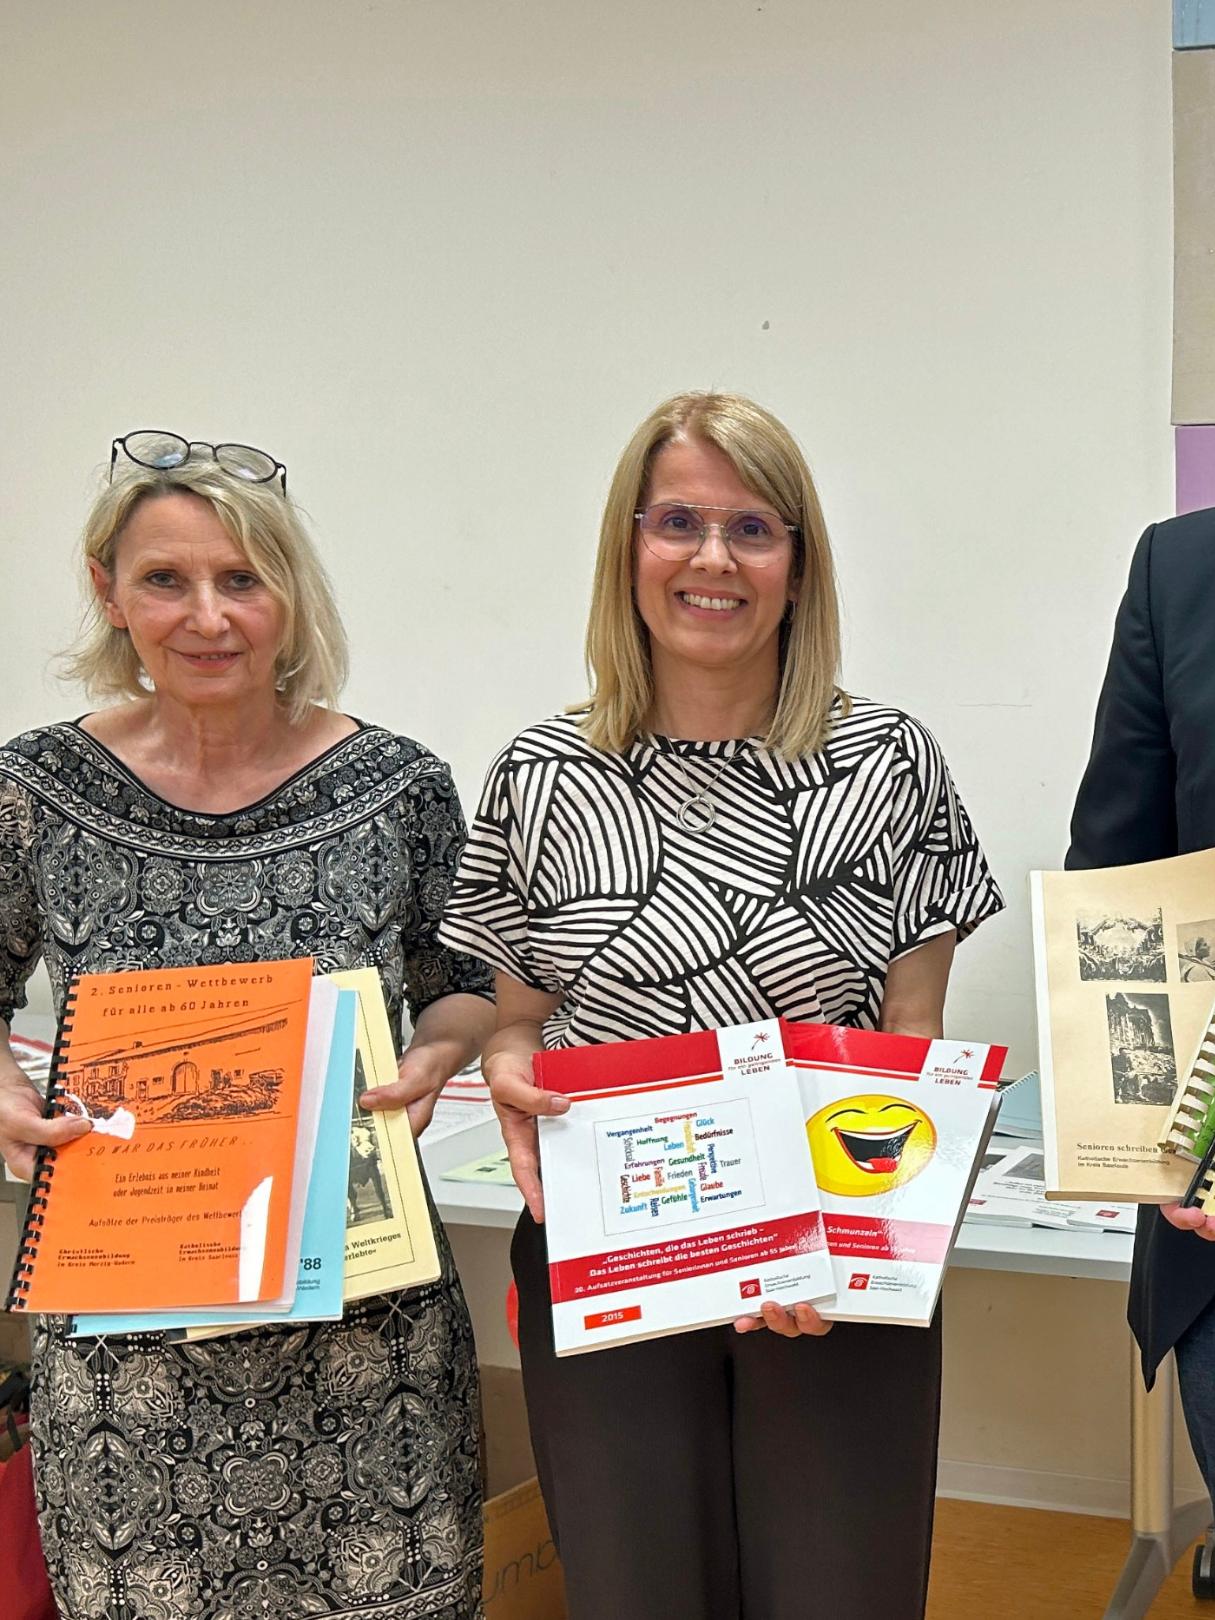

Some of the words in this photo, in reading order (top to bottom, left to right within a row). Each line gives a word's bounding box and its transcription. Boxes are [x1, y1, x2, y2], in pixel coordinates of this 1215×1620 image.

[90, 987, 103, 997] 2.
[109, 982, 172, 996] Senioren
[187, 974, 273, 988] Wettbewerb
[102, 1007, 123, 1017] für
[129, 1005, 155, 1015] alle
[161, 1003, 176, 1013] ab
[180, 1001, 195, 1011] 60
[200, 999, 249, 1010] Jahren
[734, 1052, 773, 1065] BILDUNG
[741, 1065, 770, 1076] LEBEN
[934, 1066, 968, 1076] BILDUNG
[935, 1078, 961, 1086] LEBEN
[654, 1112, 697, 1124] Begegnungen
[696, 1117, 715, 1127] Glück
[606, 1125, 653, 1138] Vergangenheit
[694, 1128, 733, 1141] Bedürfnisse
[636, 1135, 669, 1146] Hoffnung
[663, 1140, 685, 1151] Leben
[86, 1146, 106, 1157] SO
[112, 1143, 141, 1154] WAR
[146, 1141, 175, 1152] DAS
[1076, 1142, 1115, 1151] Senioren
[1117, 1144, 1158, 1153] schreiben
[624, 1157, 665, 1170] Erfahrungen
[668, 1153, 706, 1166] Gesundheit
[719, 1158, 742, 1168] Trauer
[115, 1173, 127, 1184] Ein
[128, 1170, 156, 1183] Erlebnis
[158, 1172, 169, 1180] aus
[171, 1169, 191, 1179] meiner
[193, 1166, 221, 1178] Kindheit
[631, 1173, 651, 1183] Liebe
[667, 1169, 693, 1181] Frieden
[113, 1187, 127, 1198] oder
[129, 1185, 163, 1198] Jugendzeit
[166, 1185, 173, 1194] in
[175, 1184, 195, 1193] meiner
[198, 1182, 219, 1192] Heimat
[700, 1181, 724, 1191] Glaube
[661, 1193, 688, 1205] Gefühle
[700, 1190, 742, 1203] Erwartungen
[620, 1202, 647, 1215] Zukunft
[88, 1214, 122, 1228] Aufsätze
[125, 1215, 138, 1226] der
[141, 1213, 183, 1226] Preisträger
[351, 1232, 402, 1249] Weltkrieges
[665, 1241, 679, 1253] die
[680, 1239, 696, 1250] das
[698, 1234, 724, 1247] Leben
[726, 1227, 758, 1241] schrieb
[589, 1267, 606, 1277] Das
[608, 1261, 635, 1275] Leben
[637, 1256, 674, 1269] schreibt
[675, 1251, 688, 1262] die
[689, 1245, 720, 1259] besten
[586, 1271, 662, 1292] Aufsatzveranstaltung
[662, 1267, 673, 1277] für
[673, 1261, 714, 1275] Seniorinnen
[715, 1257, 729, 1266] und
[729, 1252, 759, 1264] Senioren
[601, 1312, 624, 1323] 2015
